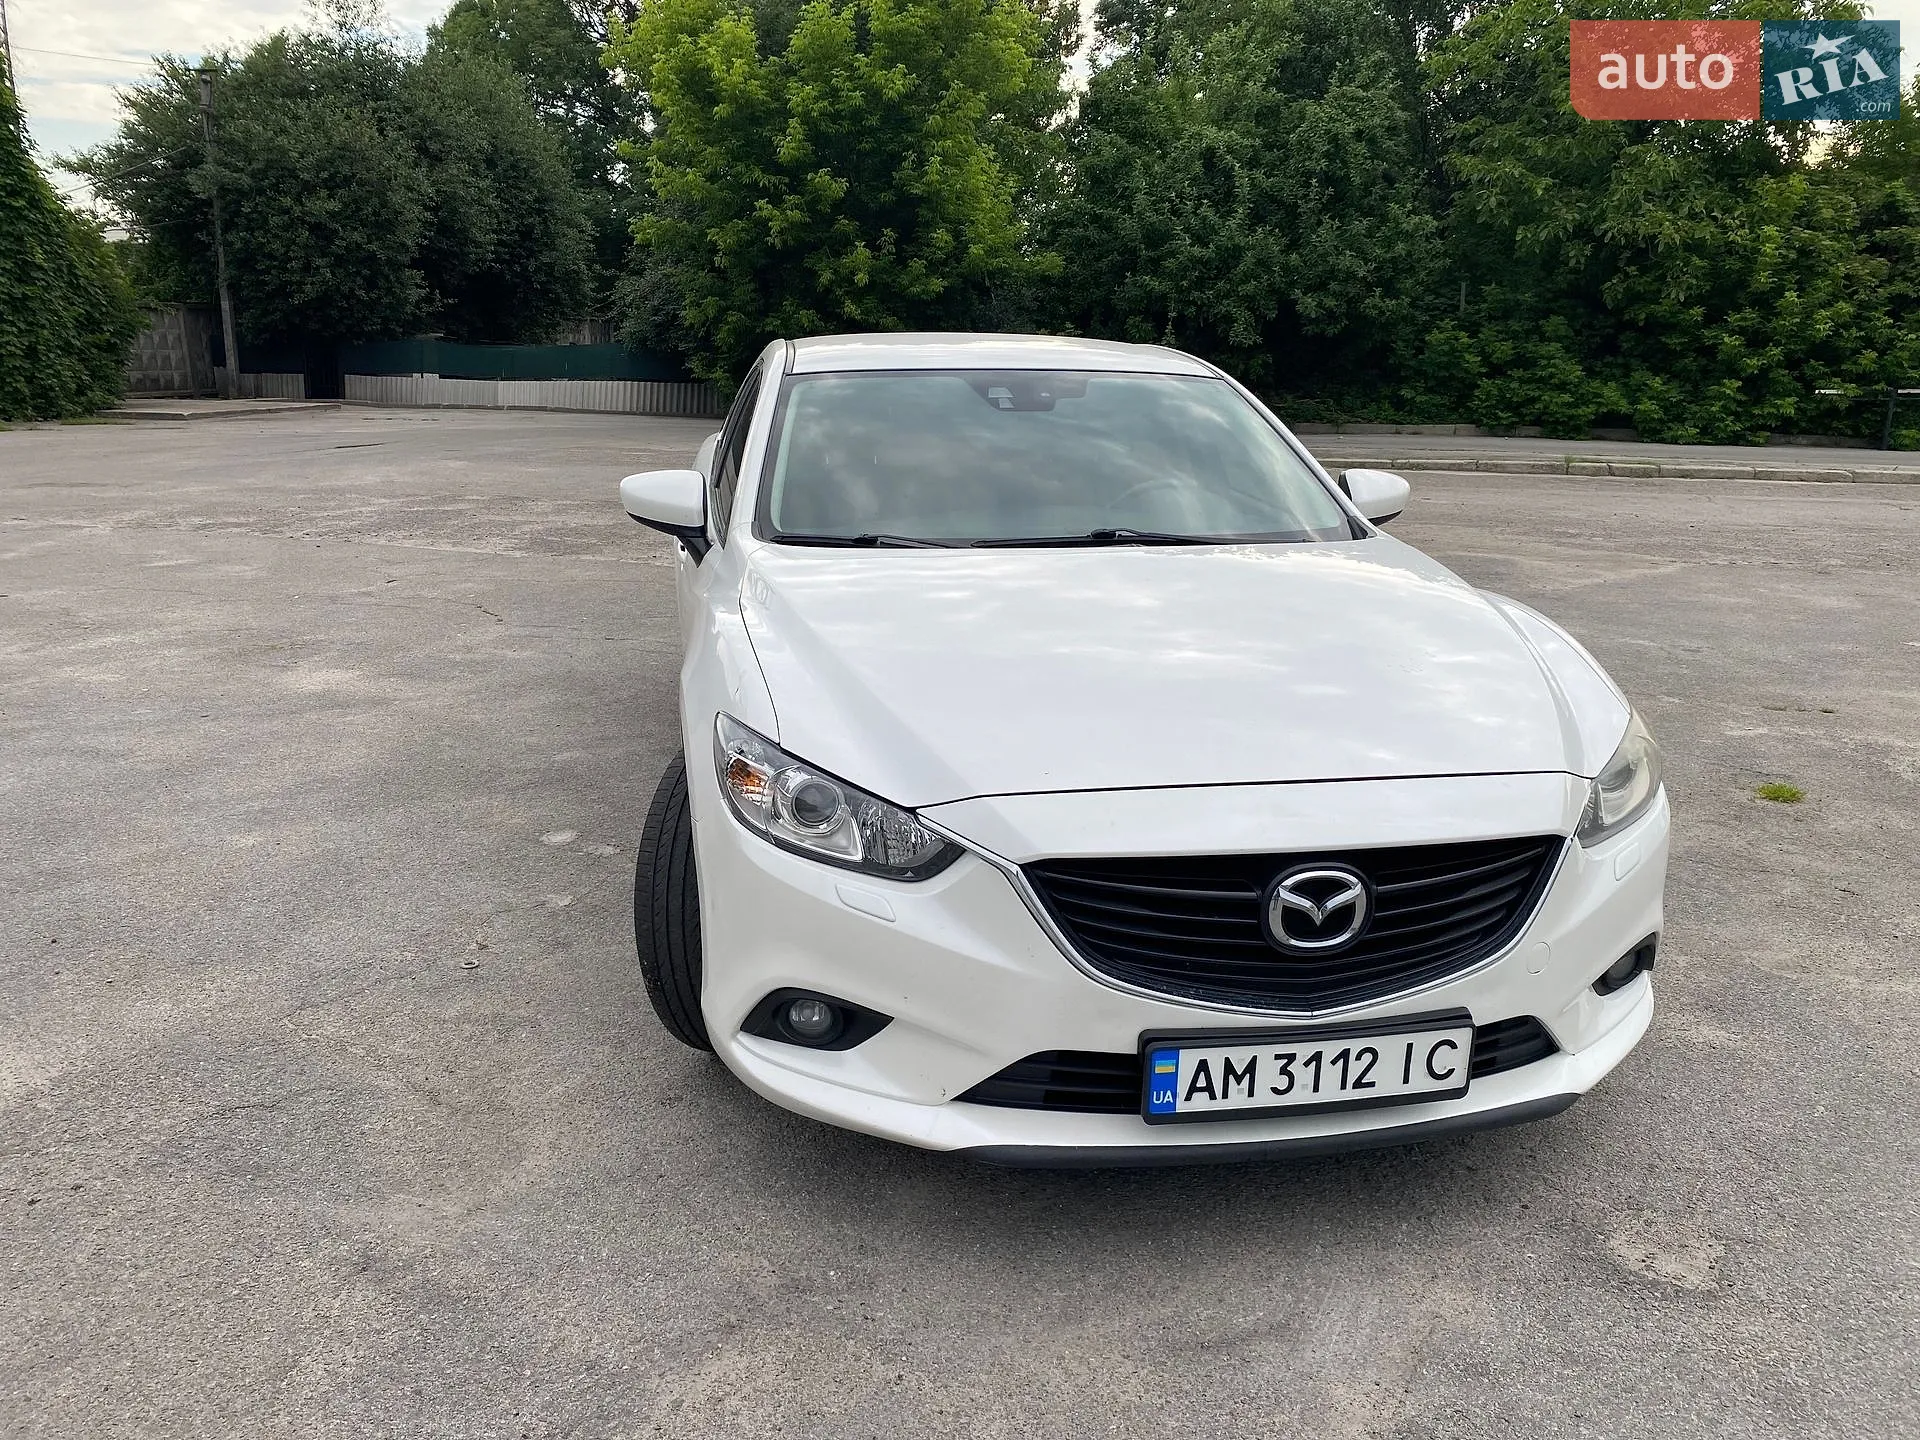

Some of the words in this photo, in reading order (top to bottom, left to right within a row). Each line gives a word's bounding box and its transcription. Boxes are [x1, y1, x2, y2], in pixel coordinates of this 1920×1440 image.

[1184, 1055, 1258, 1102] AM
[1269, 1046, 1380, 1096] 3112
[1401, 1039, 1459, 1085] IC
[1152, 1090, 1174, 1105] UA
